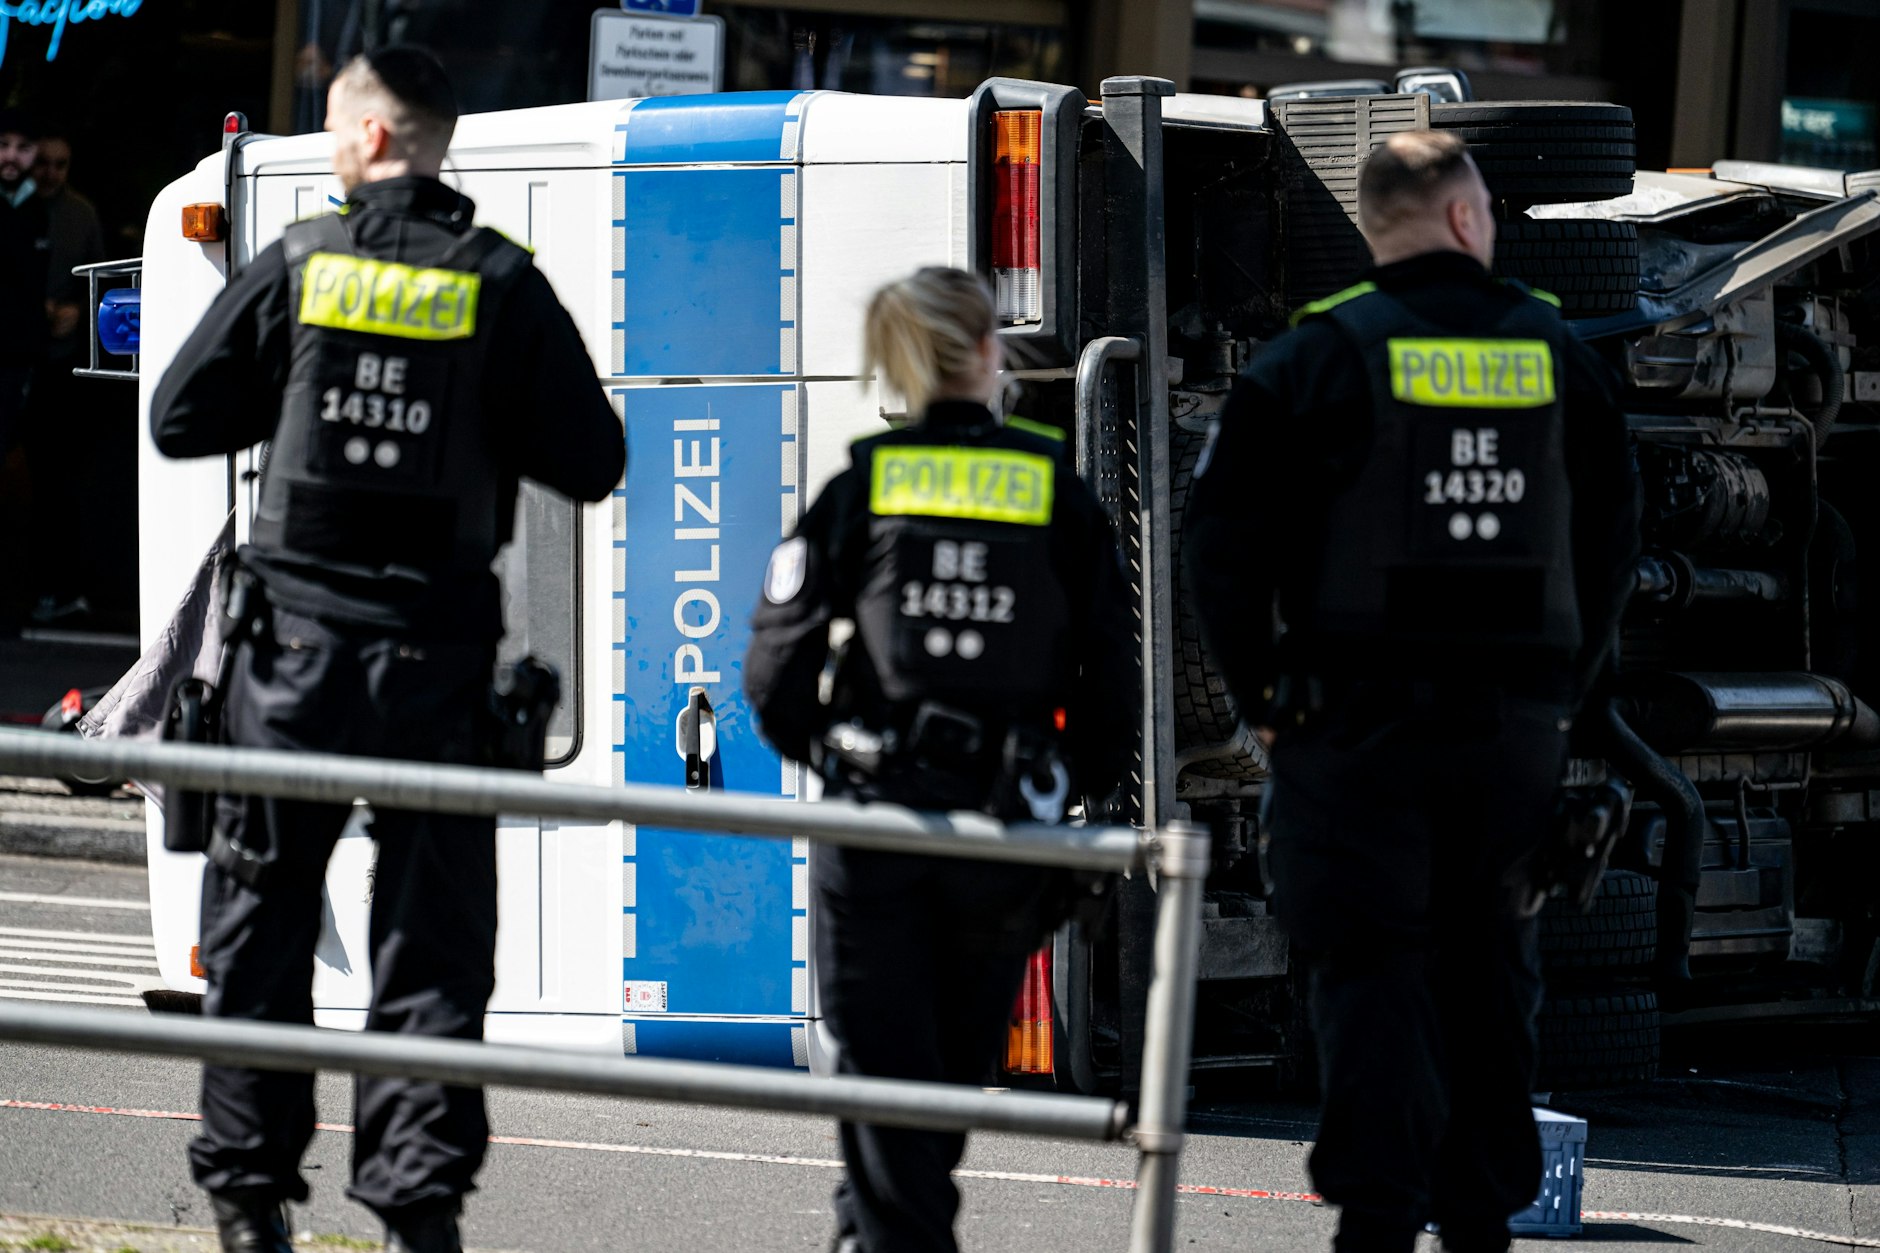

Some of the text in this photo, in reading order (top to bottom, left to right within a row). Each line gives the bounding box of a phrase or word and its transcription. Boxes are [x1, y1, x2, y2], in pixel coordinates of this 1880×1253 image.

[312, 267, 468, 331] POLIZEI
[355, 351, 409, 394] BE
[1402, 350, 1546, 399] POLIZEI
[320, 386, 432, 435] 14310
[1451, 427, 1500, 466] BE
[882, 456, 1043, 513] POLIZEI
[1424, 468, 1526, 504] 14320
[673, 418, 721, 684] POLIZEI
[932, 539, 989, 582] BE
[900, 580, 1016, 623] 14312
